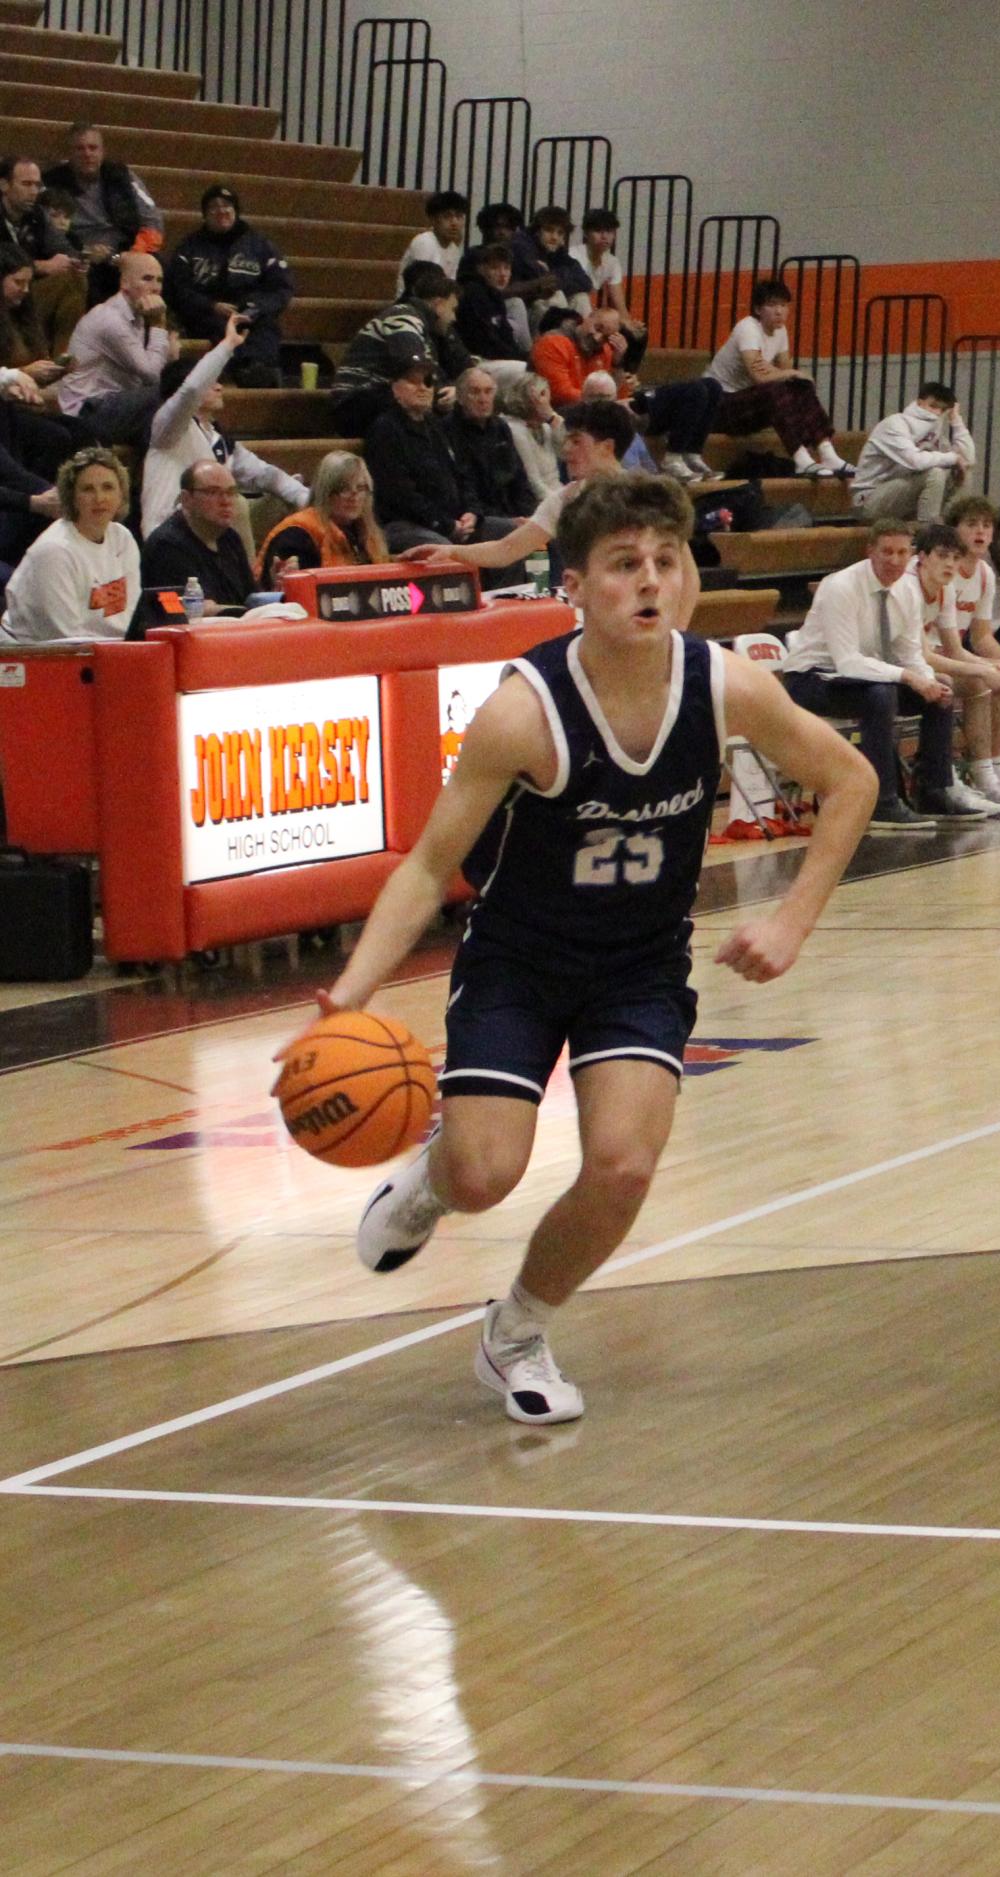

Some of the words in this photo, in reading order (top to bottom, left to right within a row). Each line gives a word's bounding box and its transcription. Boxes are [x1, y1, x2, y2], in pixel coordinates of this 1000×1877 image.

[190, 728, 264, 828] JOHN
[268, 716, 370, 817] HERSEY
[227, 833, 265, 860] HIGH
[269, 823, 335, 854] SCHOOL
